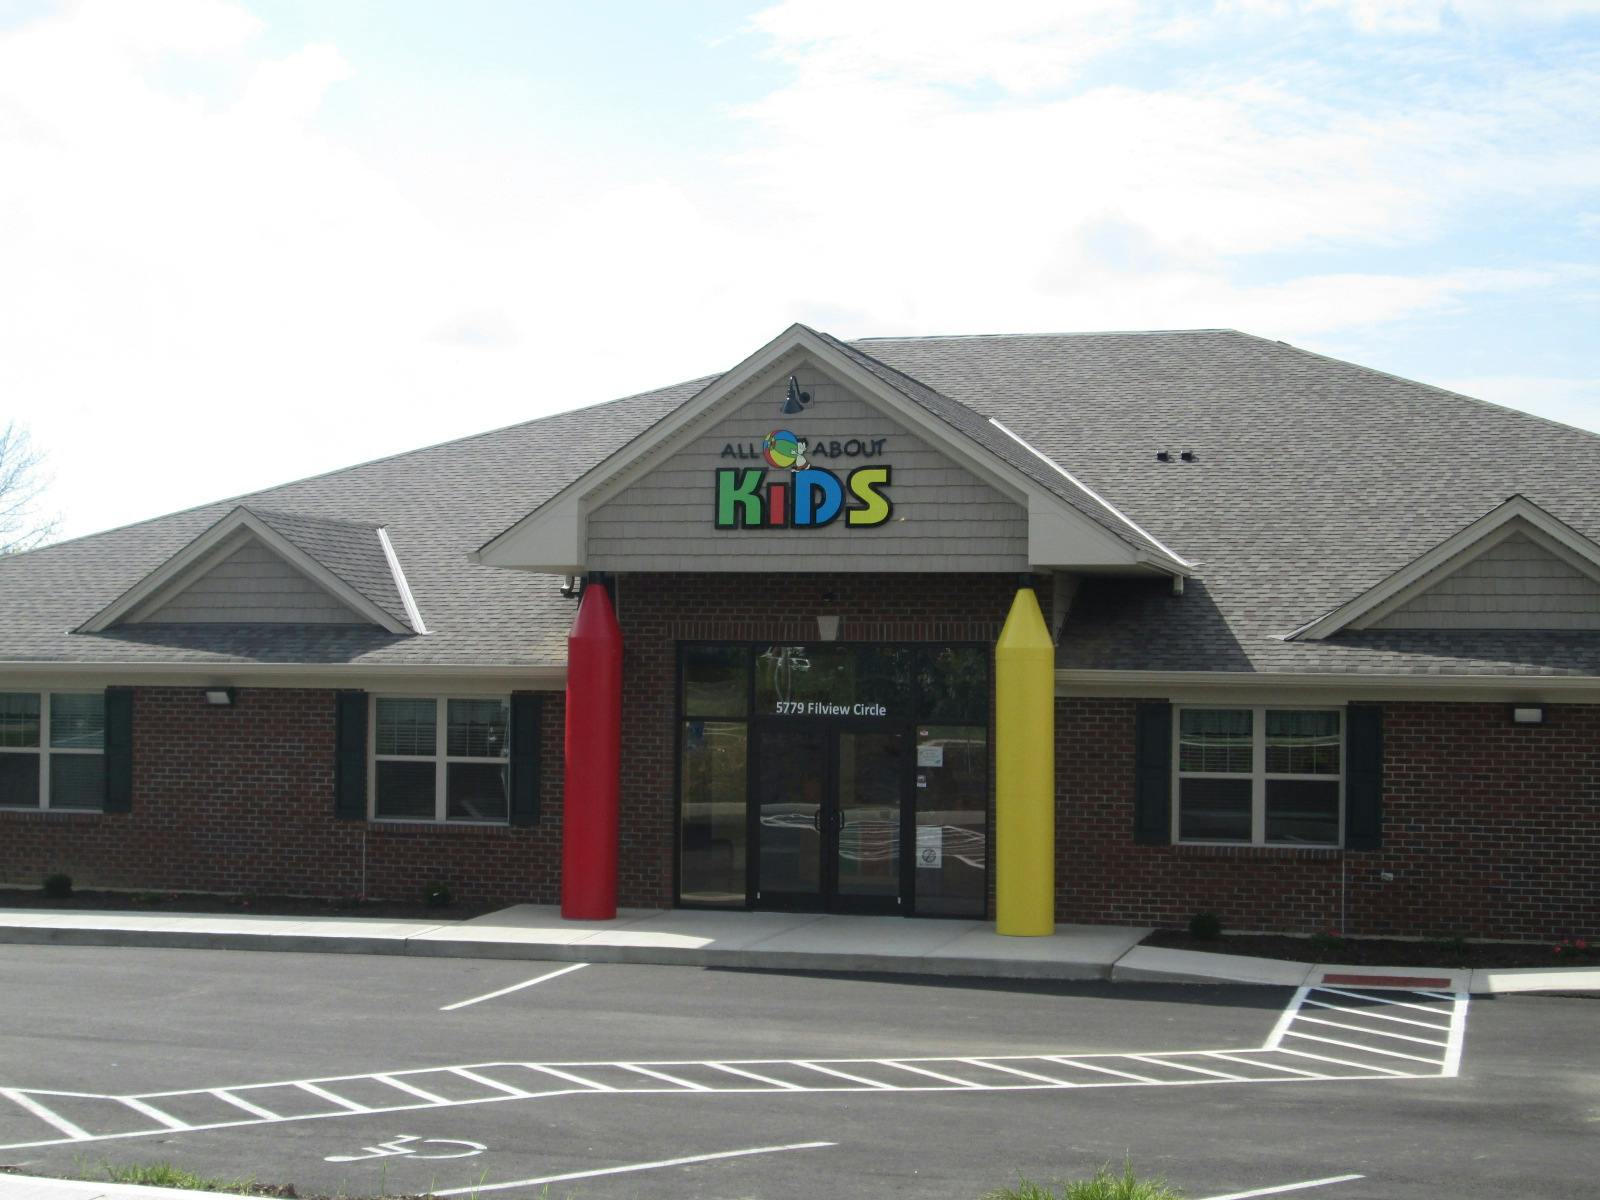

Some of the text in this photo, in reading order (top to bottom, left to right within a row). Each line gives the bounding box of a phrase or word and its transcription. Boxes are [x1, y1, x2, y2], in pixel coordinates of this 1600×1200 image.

[721, 438, 887, 460] ALL ABOUT
[776, 701, 887, 716] 5779 Filview Circle
